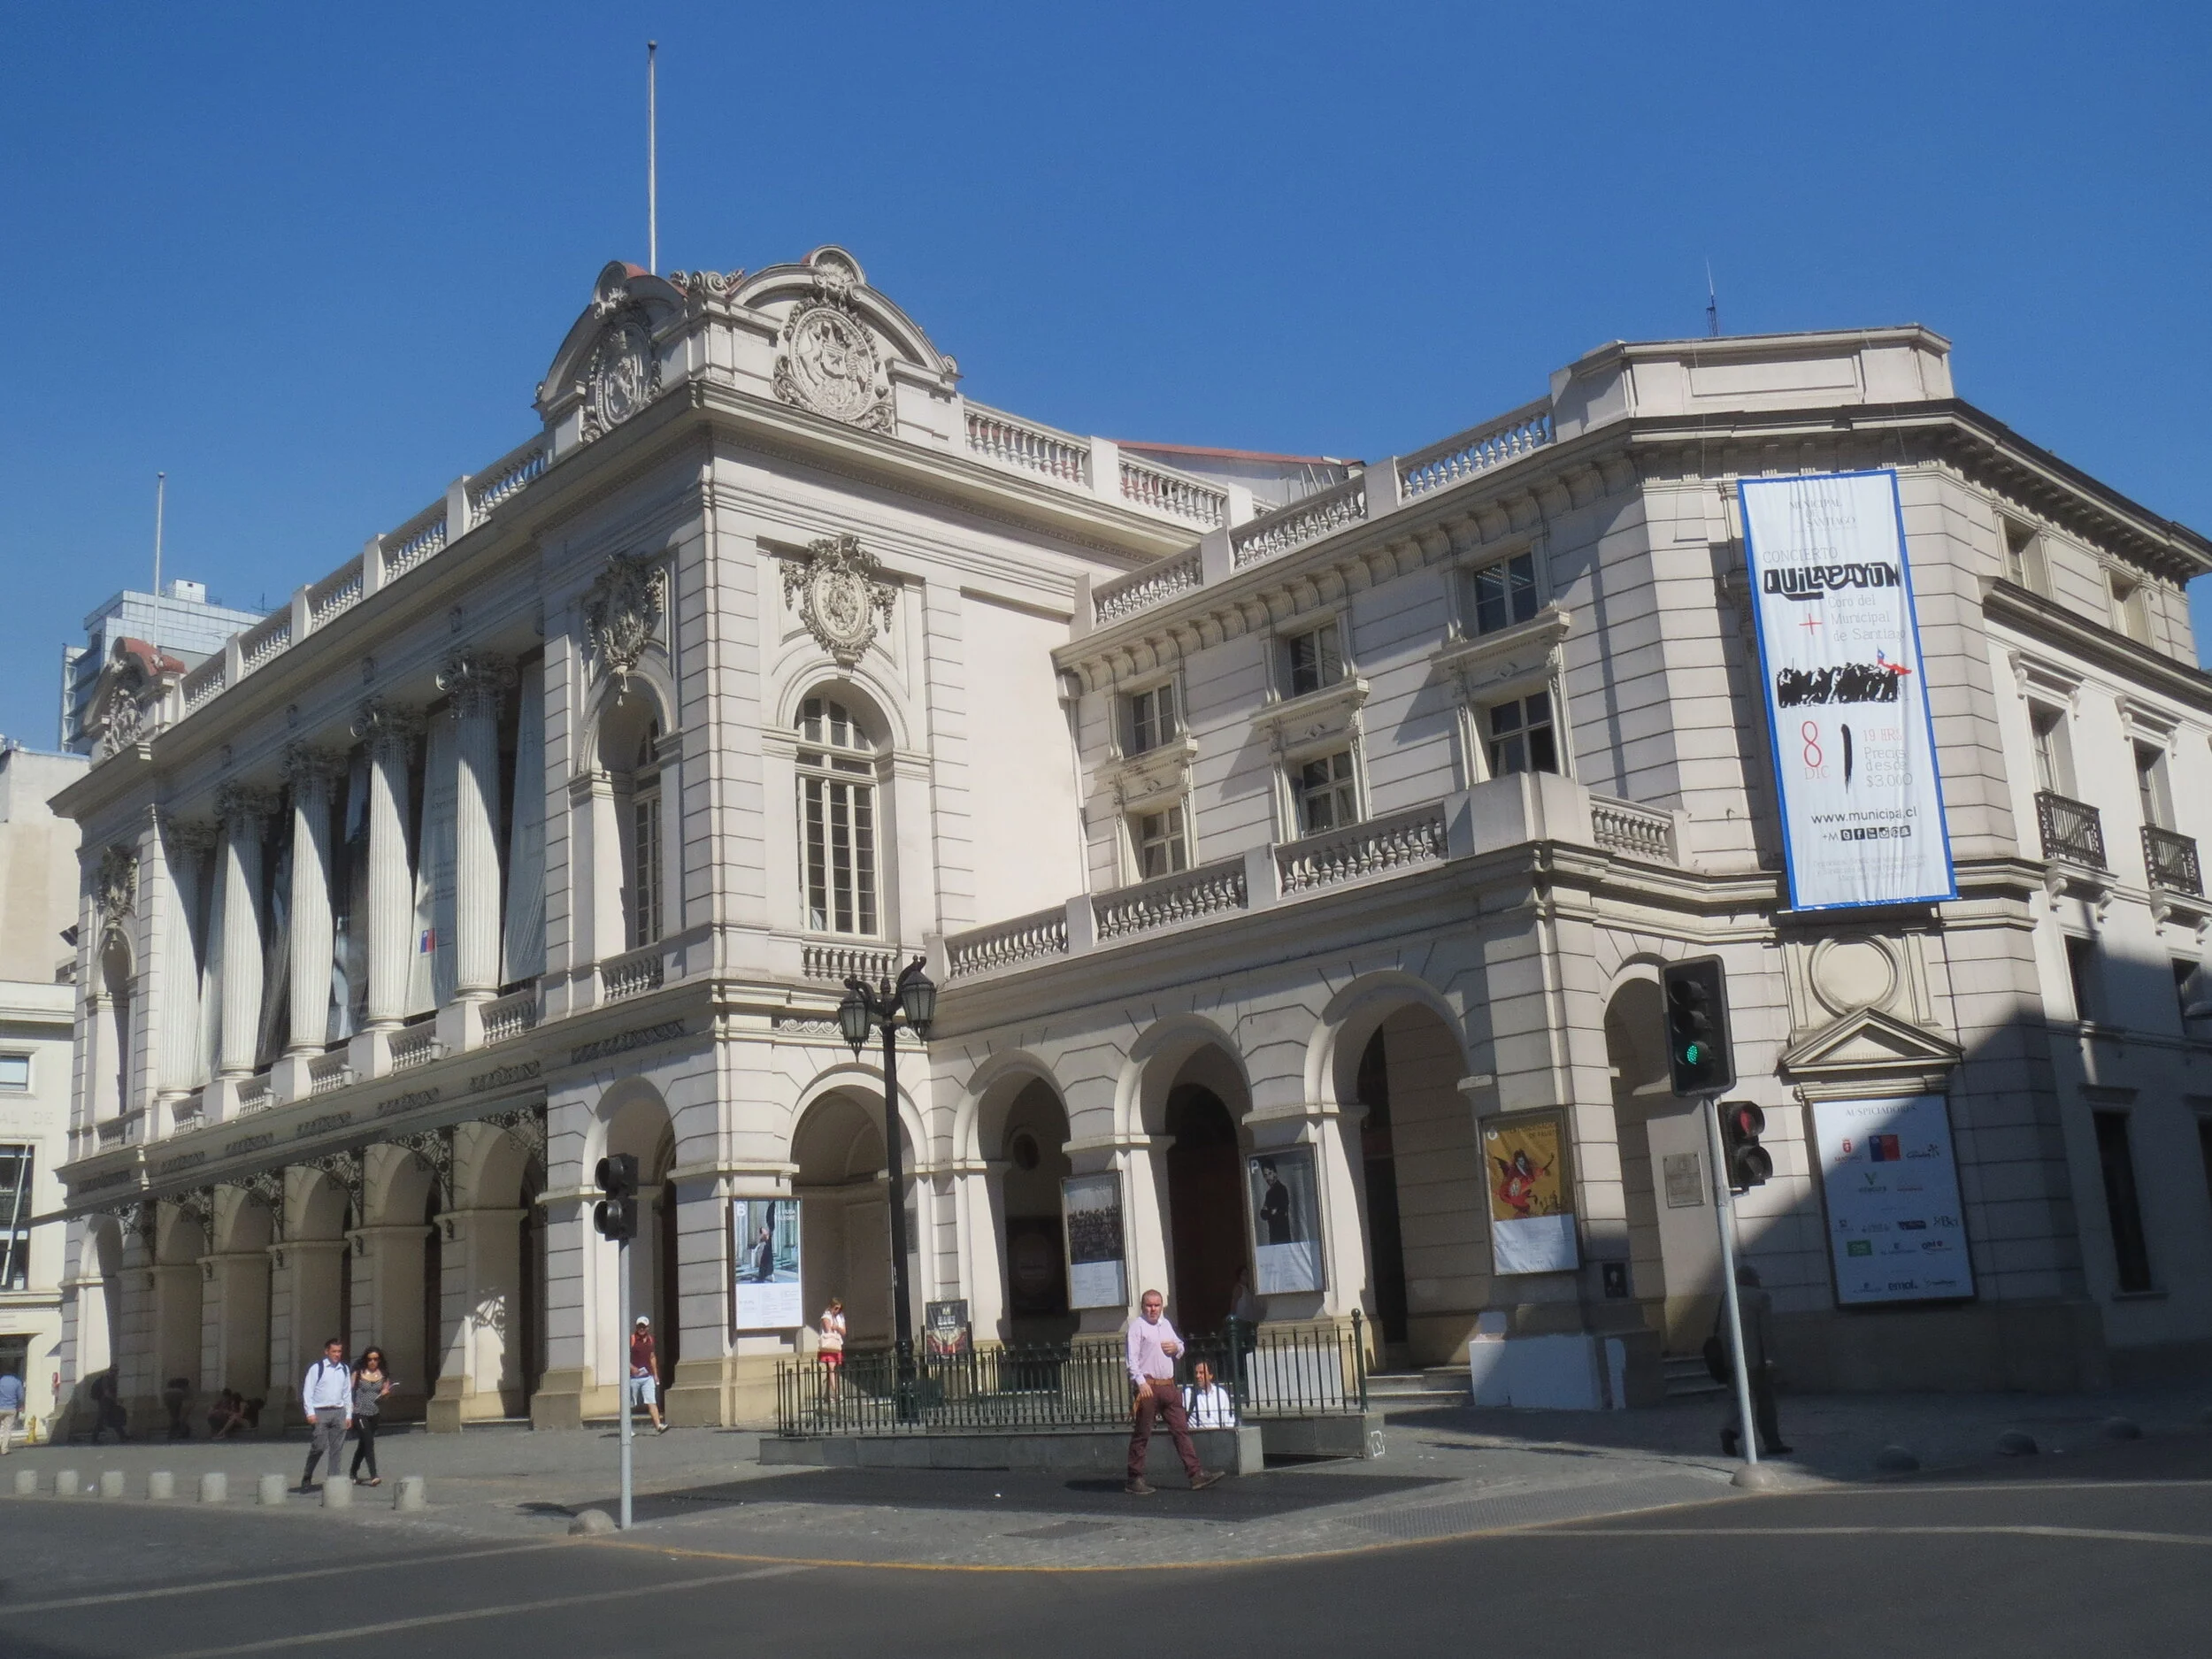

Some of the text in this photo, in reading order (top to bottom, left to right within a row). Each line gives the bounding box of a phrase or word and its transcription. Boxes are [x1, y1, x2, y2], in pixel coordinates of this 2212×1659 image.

[1763, 547, 1838, 564] CONCIERTO
[1828, 594, 1876, 609] Coro del
[1831, 611, 1890, 626] Municipal
[1833, 630, 1847, 642] de
[1863, 728, 1876, 742] 19
[1801, 721, 1823, 767] 8
[1804, 764, 1831, 780] DIC
